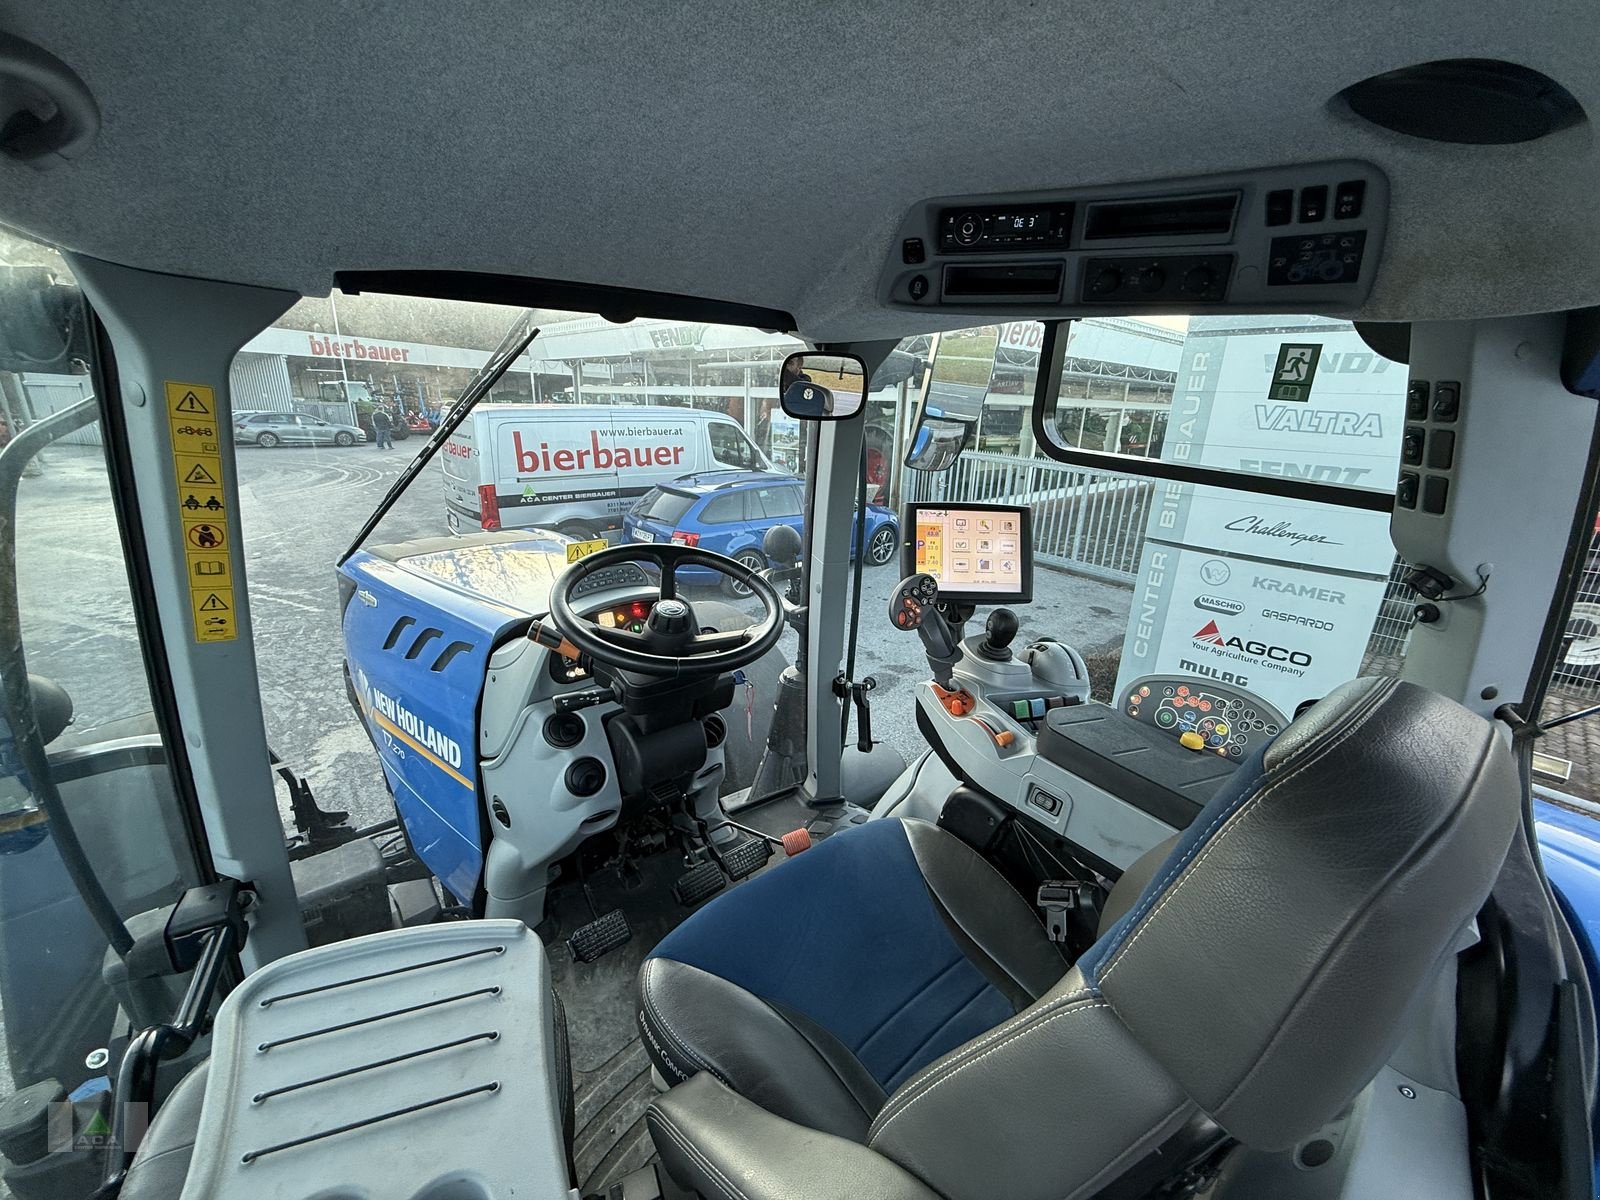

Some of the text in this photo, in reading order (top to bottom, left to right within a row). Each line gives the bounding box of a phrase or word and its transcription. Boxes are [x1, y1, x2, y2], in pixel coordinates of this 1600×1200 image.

[1029, 217, 1035, 228] 3
[308, 335, 409, 362] bierbauer
[600, 426, 683, 437] www.bierbauer.at
[1254, 404, 1383, 438] VALTRA
[512, 430, 685, 473] bierbauer
[520, 491, 616, 504] ACA CENTER BIERBAUER
[1224, 515, 1344, 546] Challenger
[1133, 551, 1168, 659] CENTER
[1201, 597, 1243, 611] MASCHIO
[1252, 576, 1346, 605] KRAMER
[1262, 608, 1334, 632] GASPARDO
[1192, 641, 1305, 678] Your Agriculture Company
[1225, 636, 1312, 667] AGCO
[373, 687, 462, 769] NEW HOLLAND
